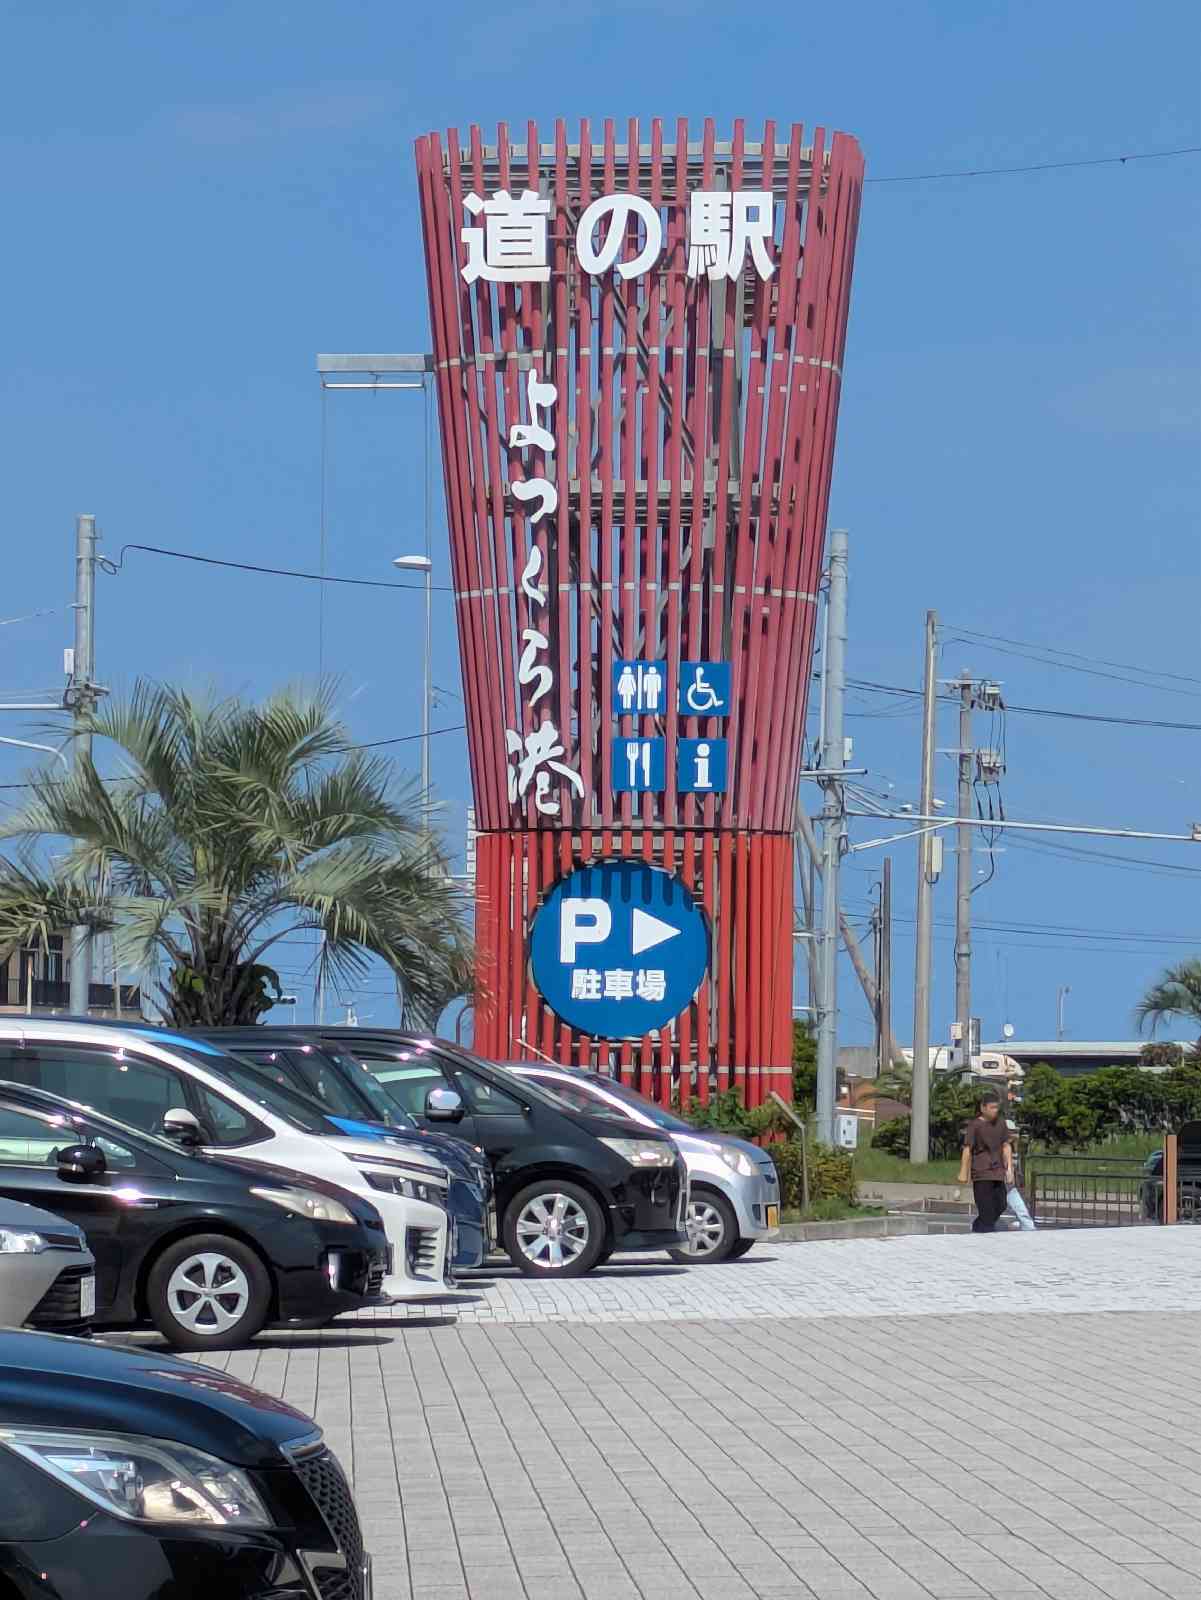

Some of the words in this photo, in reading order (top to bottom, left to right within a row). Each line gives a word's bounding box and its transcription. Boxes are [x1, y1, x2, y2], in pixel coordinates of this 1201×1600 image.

[460, 190, 776, 284] 道の駅
[506, 368, 585, 816] よつくら港
[559, 897, 612, 964] P
[571, 968, 666, 1001] 駐車場
